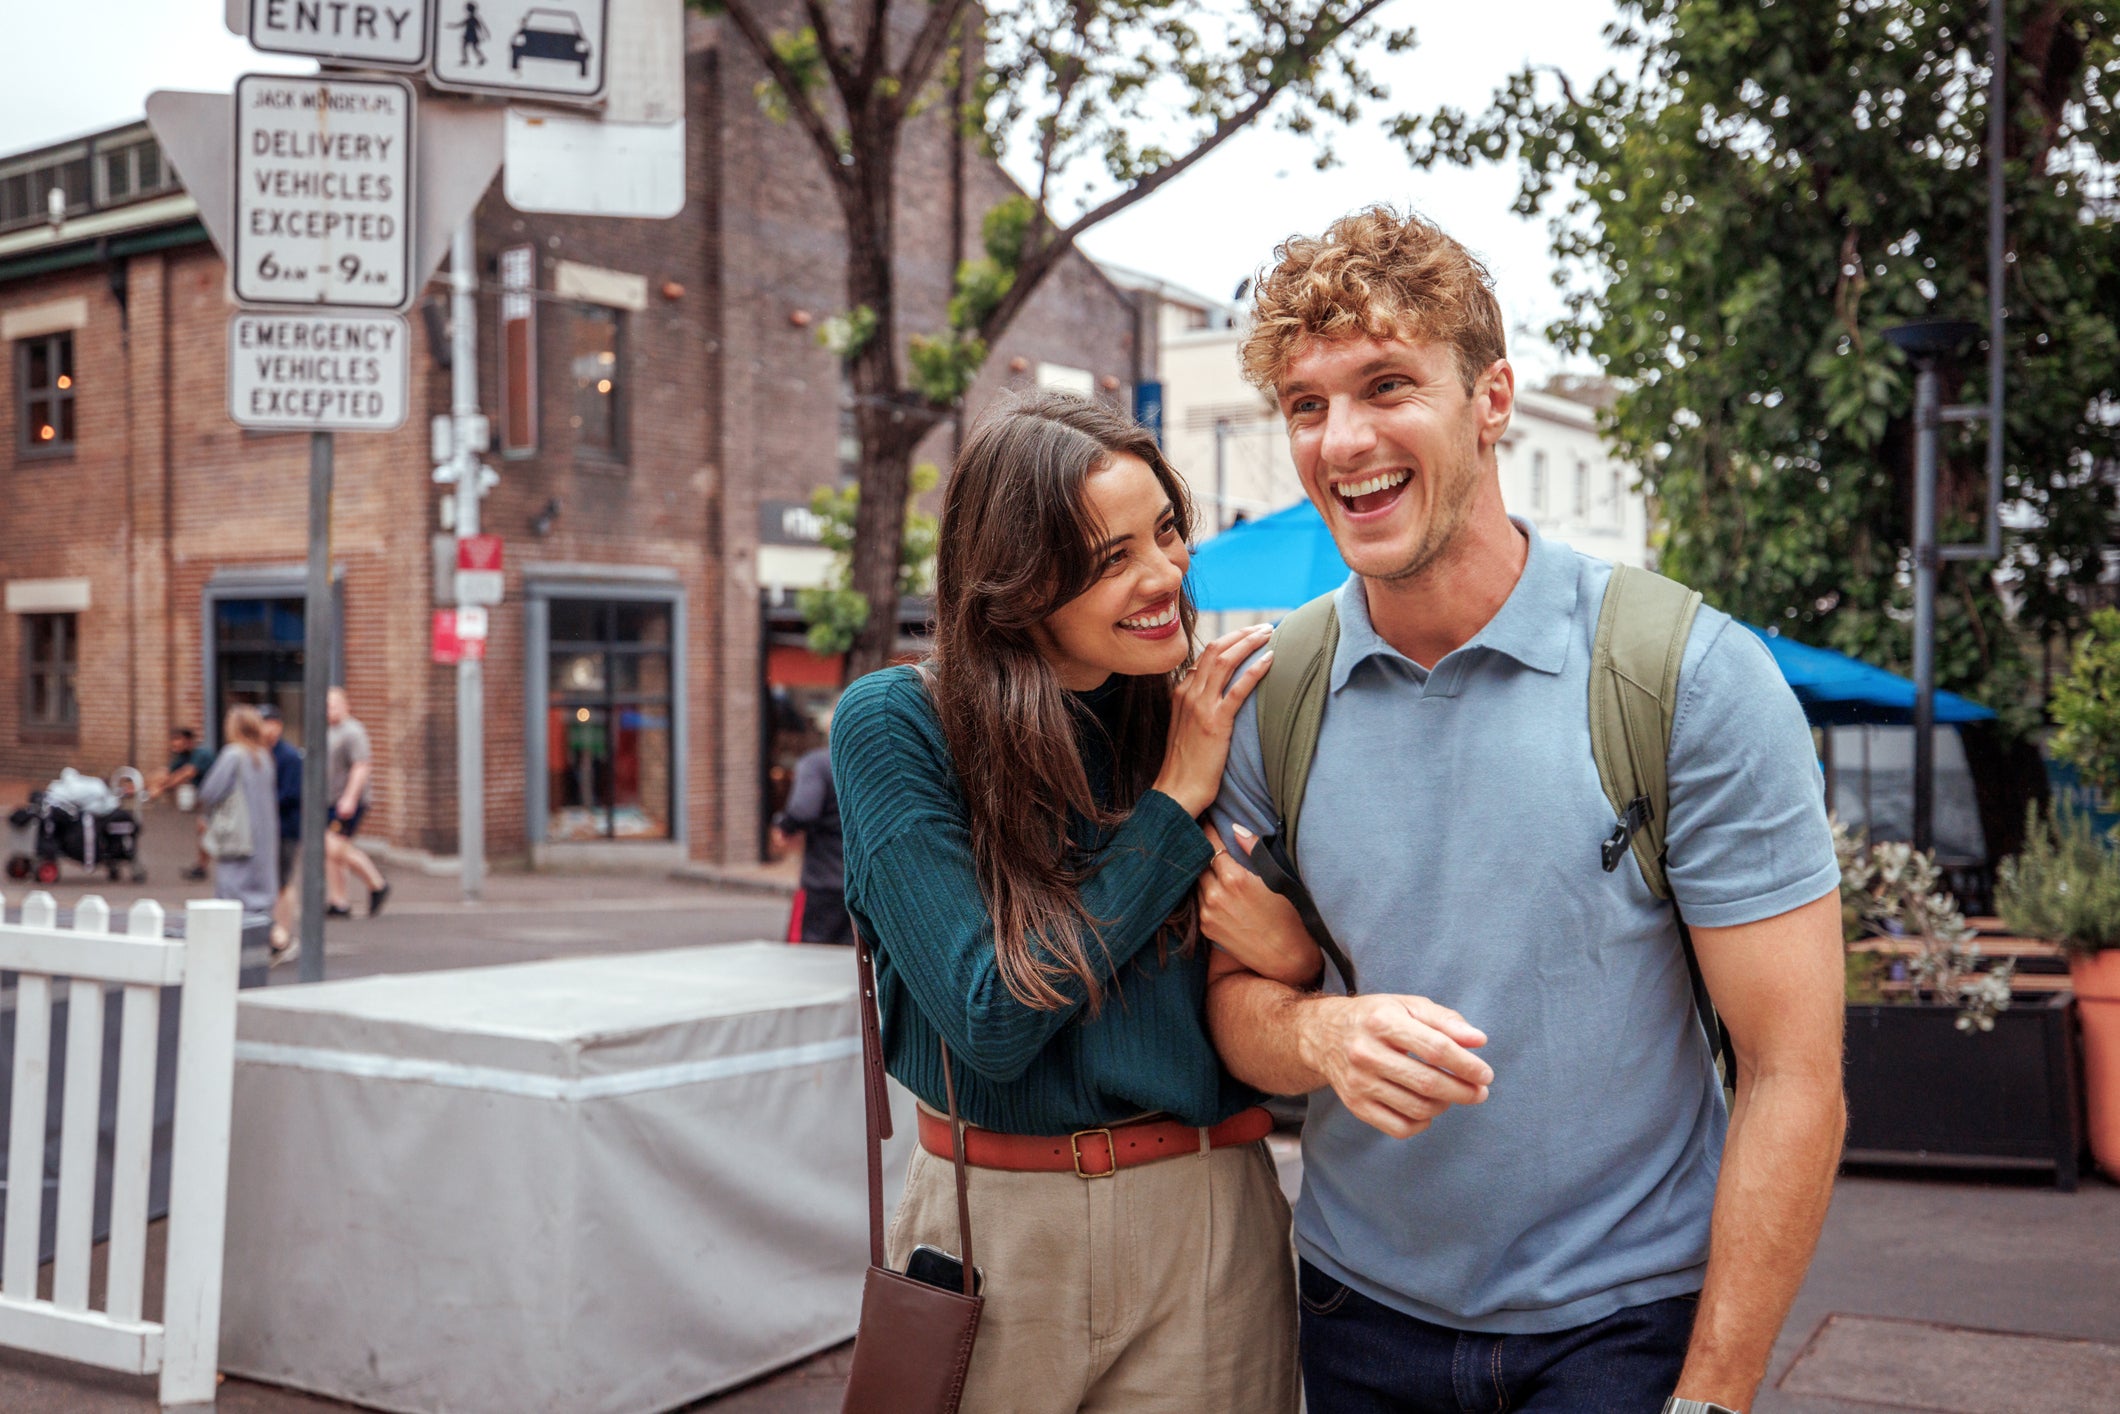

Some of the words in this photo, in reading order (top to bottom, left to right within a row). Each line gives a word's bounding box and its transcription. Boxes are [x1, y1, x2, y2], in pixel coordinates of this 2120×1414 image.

[267, 0, 411, 41] ENTRY
[254, 87, 297, 110] JACK
[253, 129, 393, 161] DELIVERY
[255, 168, 393, 200] VEHICLES
[250, 208, 395, 241] EXCEPTED
[239, 321, 394, 352] EMERGENCY
[256, 356, 381, 385] VEHICLES
[250, 387, 383, 419] EXCEPTED
